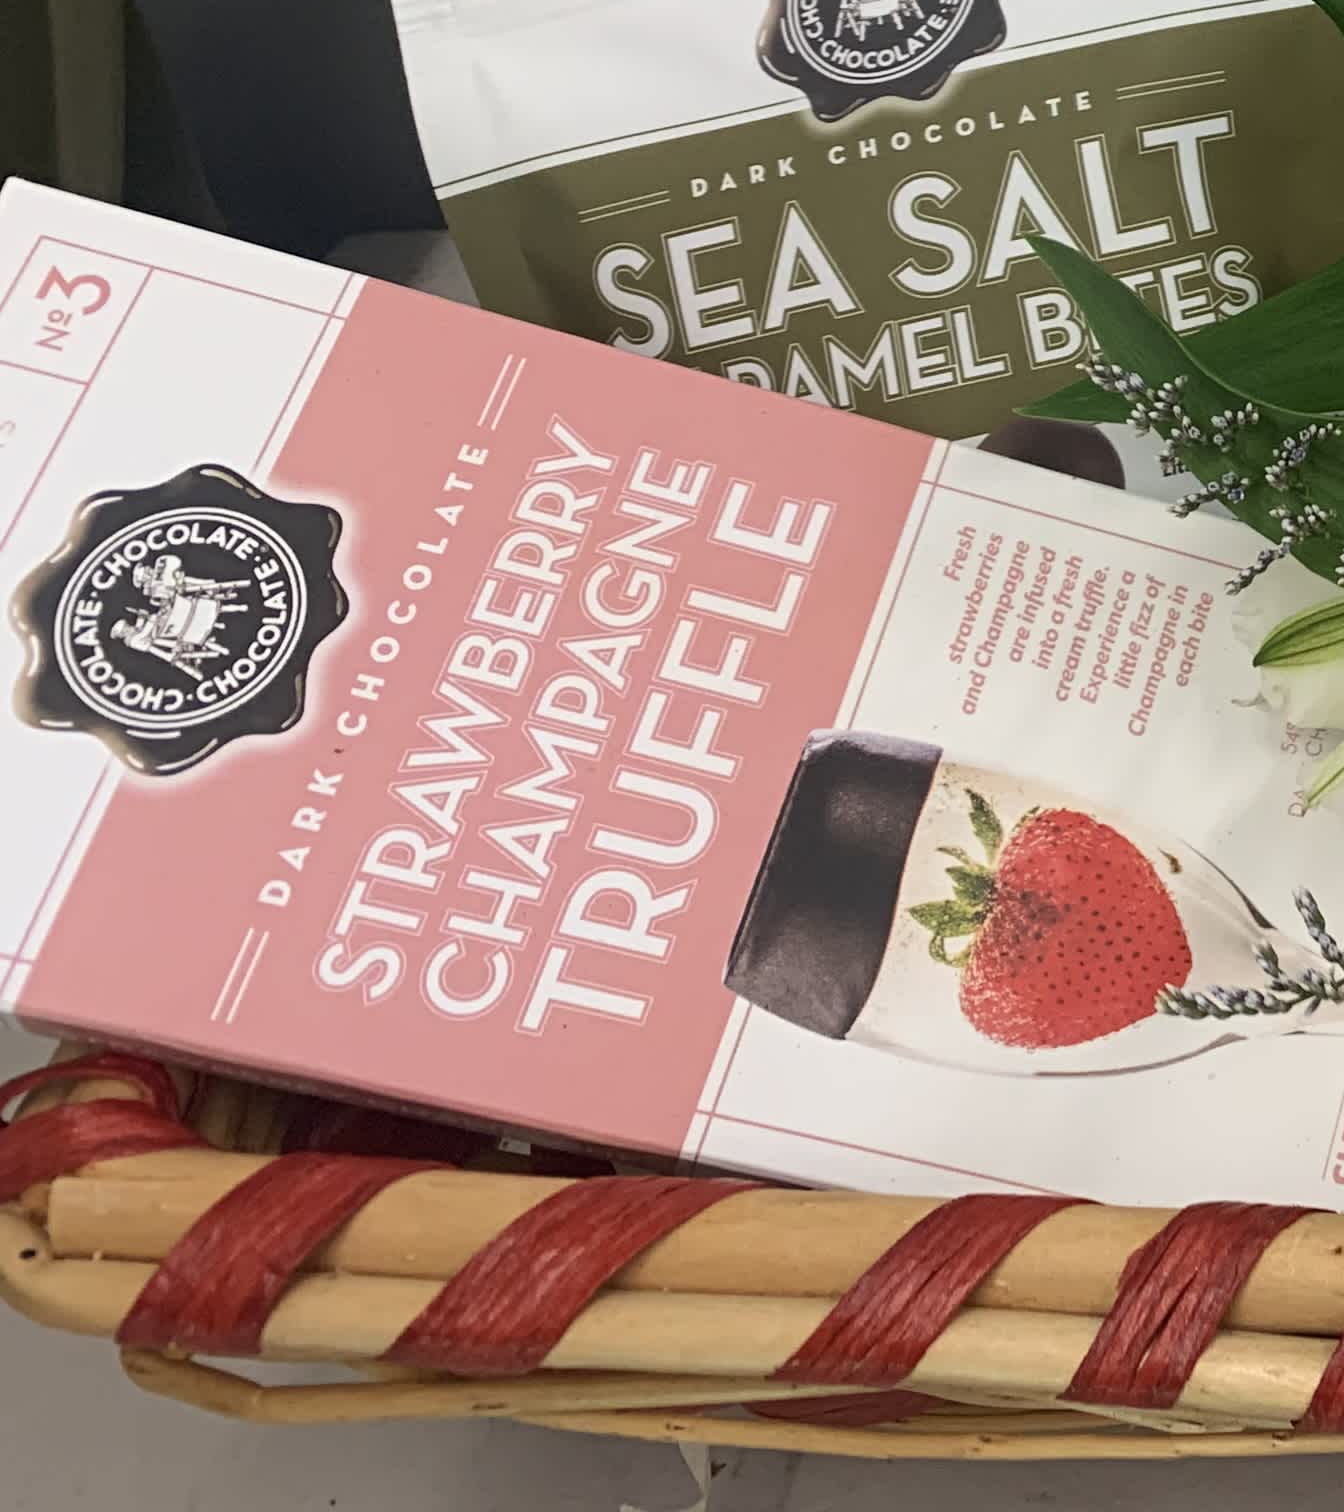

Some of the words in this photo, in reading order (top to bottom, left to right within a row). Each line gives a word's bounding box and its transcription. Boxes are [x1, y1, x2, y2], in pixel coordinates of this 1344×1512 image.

[819, 12, 949, 69] CHOCOLATE
[690, 155, 799, 198] DARK
[827, 90, 1094, 166] CHOCOLATE
[594, 201, 864, 360] SEA
[887, 110, 1236, 298] SALT
[91, 522, 259, 591] CHOCOLATE
[943, 524, 977, 582] Fresh
[949, 532, 1003, 665] strawberries
[1016, 545, 1057, 624] infused
[1052, 555, 1084, 609] fresh
[73, 598, 183, 712] CHOCOLATE
[196, 557, 288, 703] CHOCOLATE
[961, 669, 987, 715] and
[974, 540, 1031, 669] Champagne
[1009, 625, 1031, 663] are
[1031, 628, 1059, 670] into
[1051, 609, 1066, 625] a
[1055, 635, 1087, 703] cream
[1074, 566, 1111, 633] truffle.
[1079, 587, 1131, 705] Experience
[1121, 570, 1136, 585] a
[1111, 640, 1143, 689] little
[1128, 601, 1156, 641] fizz
[1145, 572, 1167, 600] of
[1127, 606, 1182, 737] Champagne
[1167, 584, 1190, 606] in
[1175, 637, 1202, 688] each
[1187, 591, 1215, 634] bite
[259, 768, 342, 908] DARK
[339, 443, 489, 738] CHOCOLATE
[315, 414, 619, 1004] STRAWBERRY
[420, 445, 714, 1021] CHAMPAGNE
[516, 481, 835, 1038] TRUFFLE
